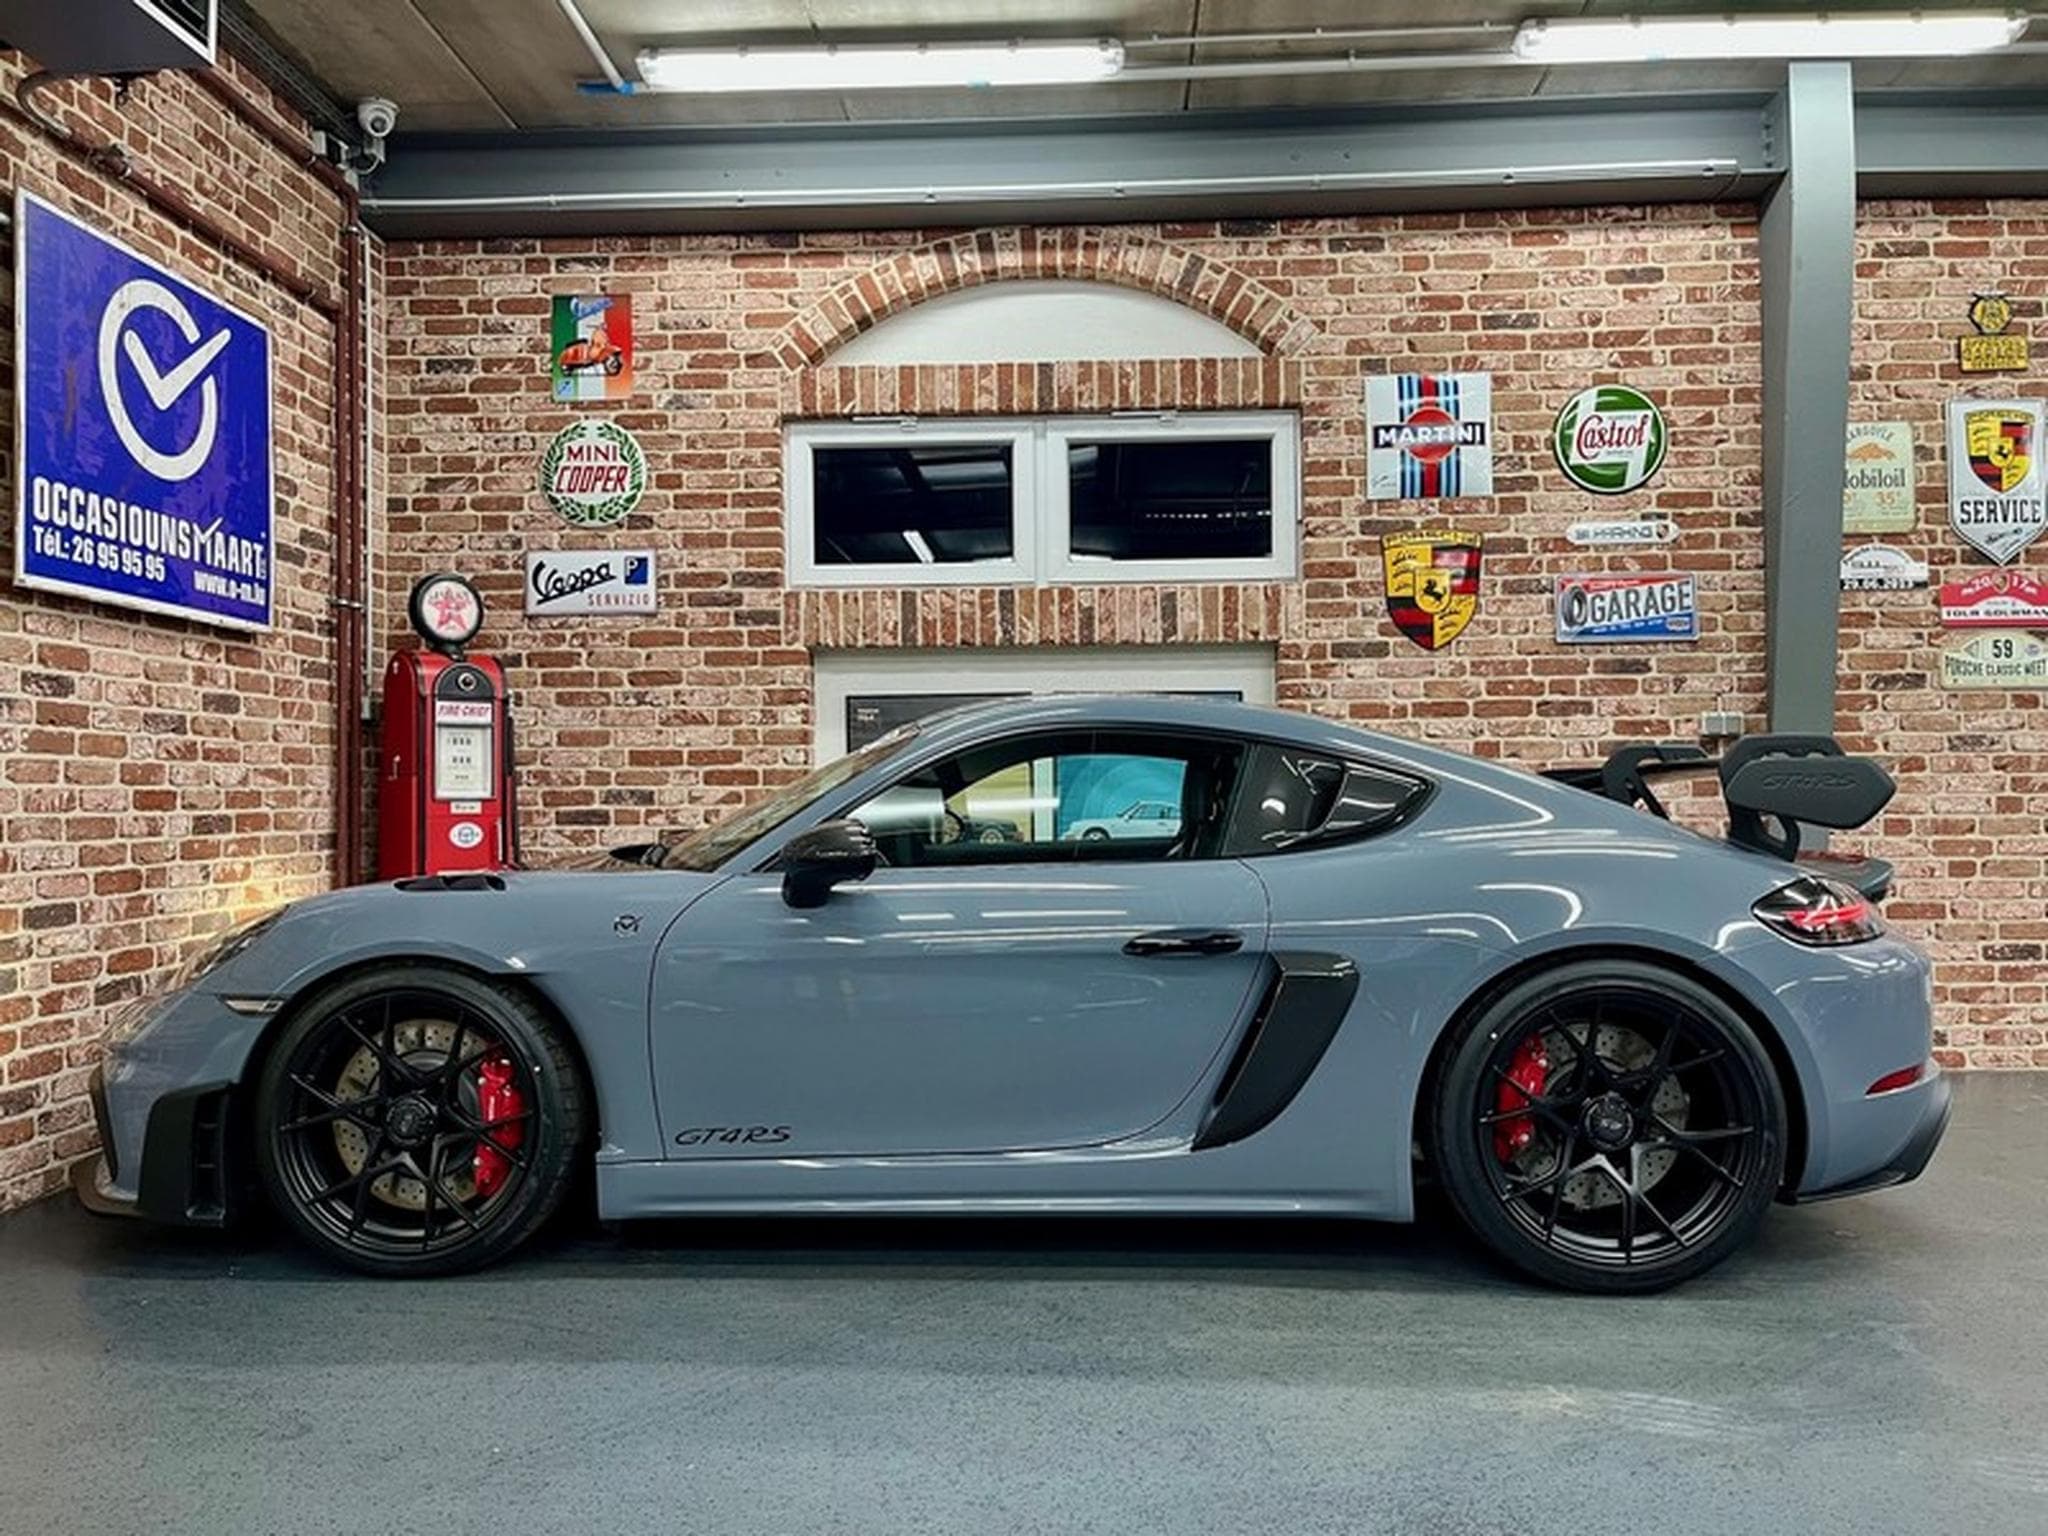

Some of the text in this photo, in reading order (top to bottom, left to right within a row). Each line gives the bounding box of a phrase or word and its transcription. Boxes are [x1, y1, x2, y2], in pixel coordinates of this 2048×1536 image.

[1378, 424, 1482, 446] MARTINI
[1577, 413, 1649, 460] Castrol
[567, 445, 617, 461] MINI
[555, 465, 628, 493] COOPER
[1960, 499, 2041, 524] SERVICE
[72, 535, 95, 566] 26
[97, 542, 119, 572] 95
[122, 548, 143, 577] 95
[145, 554, 165, 582] 95
[532, 560, 617, 605] Vespa
[1590, 580, 1692, 624] GARAGE
[1992, 639, 2013, 659] 59
